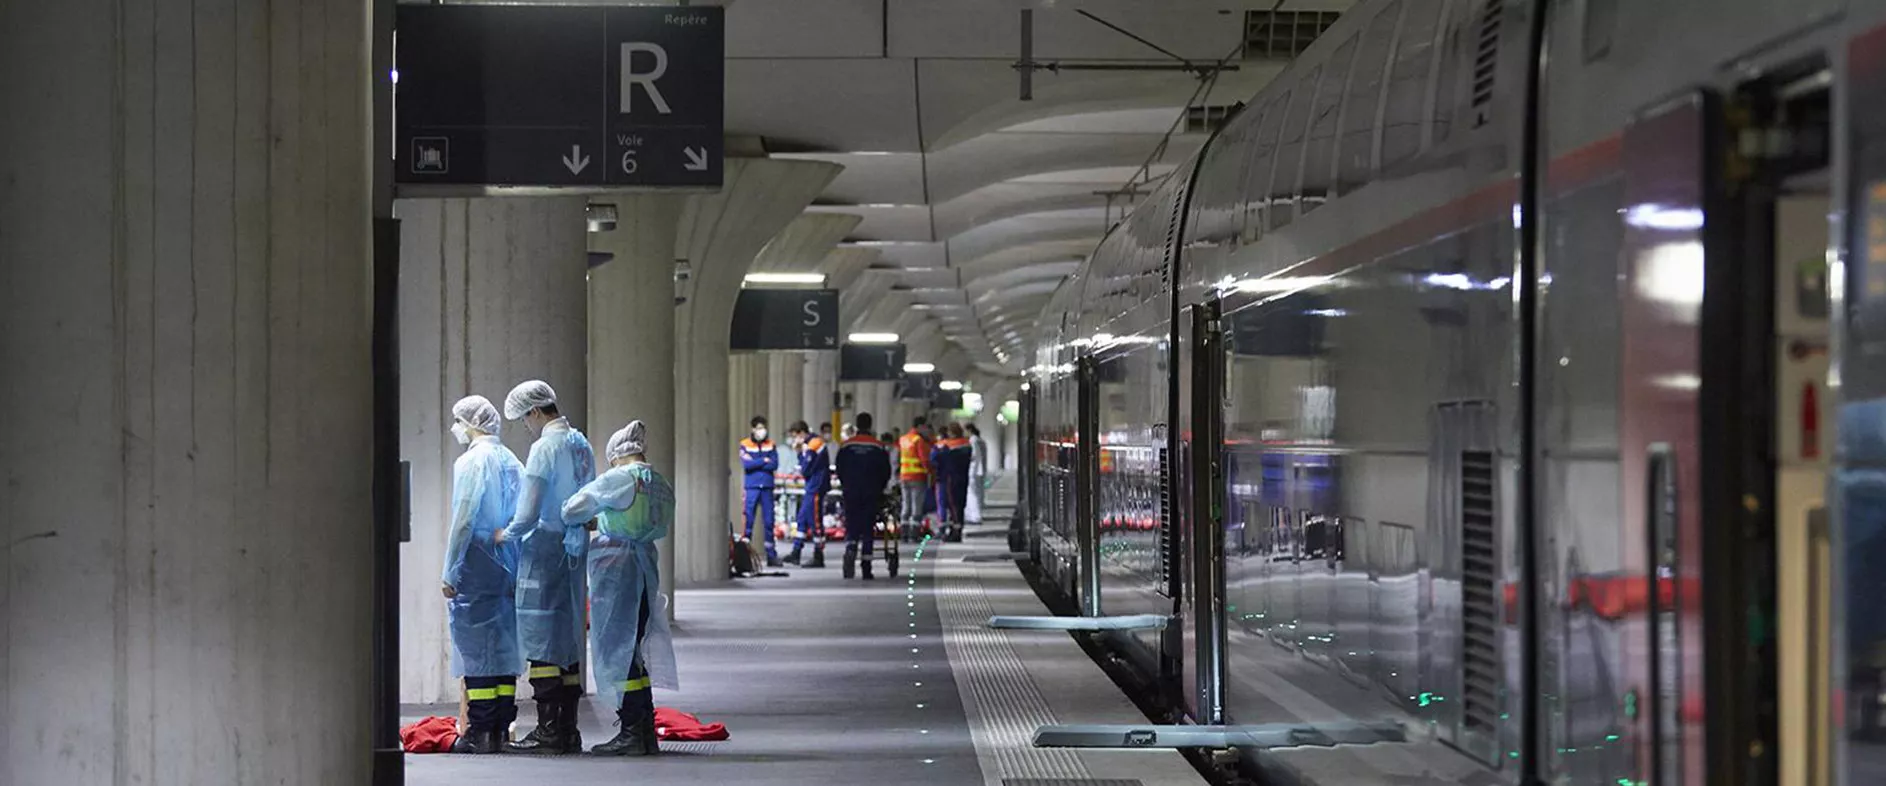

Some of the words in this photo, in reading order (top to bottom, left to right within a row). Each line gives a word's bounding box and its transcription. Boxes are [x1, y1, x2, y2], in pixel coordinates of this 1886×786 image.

[664, 13, 708, 26] Repère
[620, 41, 672, 114] R
[617, 133, 644, 146] Voie
[621, 149, 637, 174] 6
[803, 299, 820, 326] S
[884, 350, 895, 367] T
